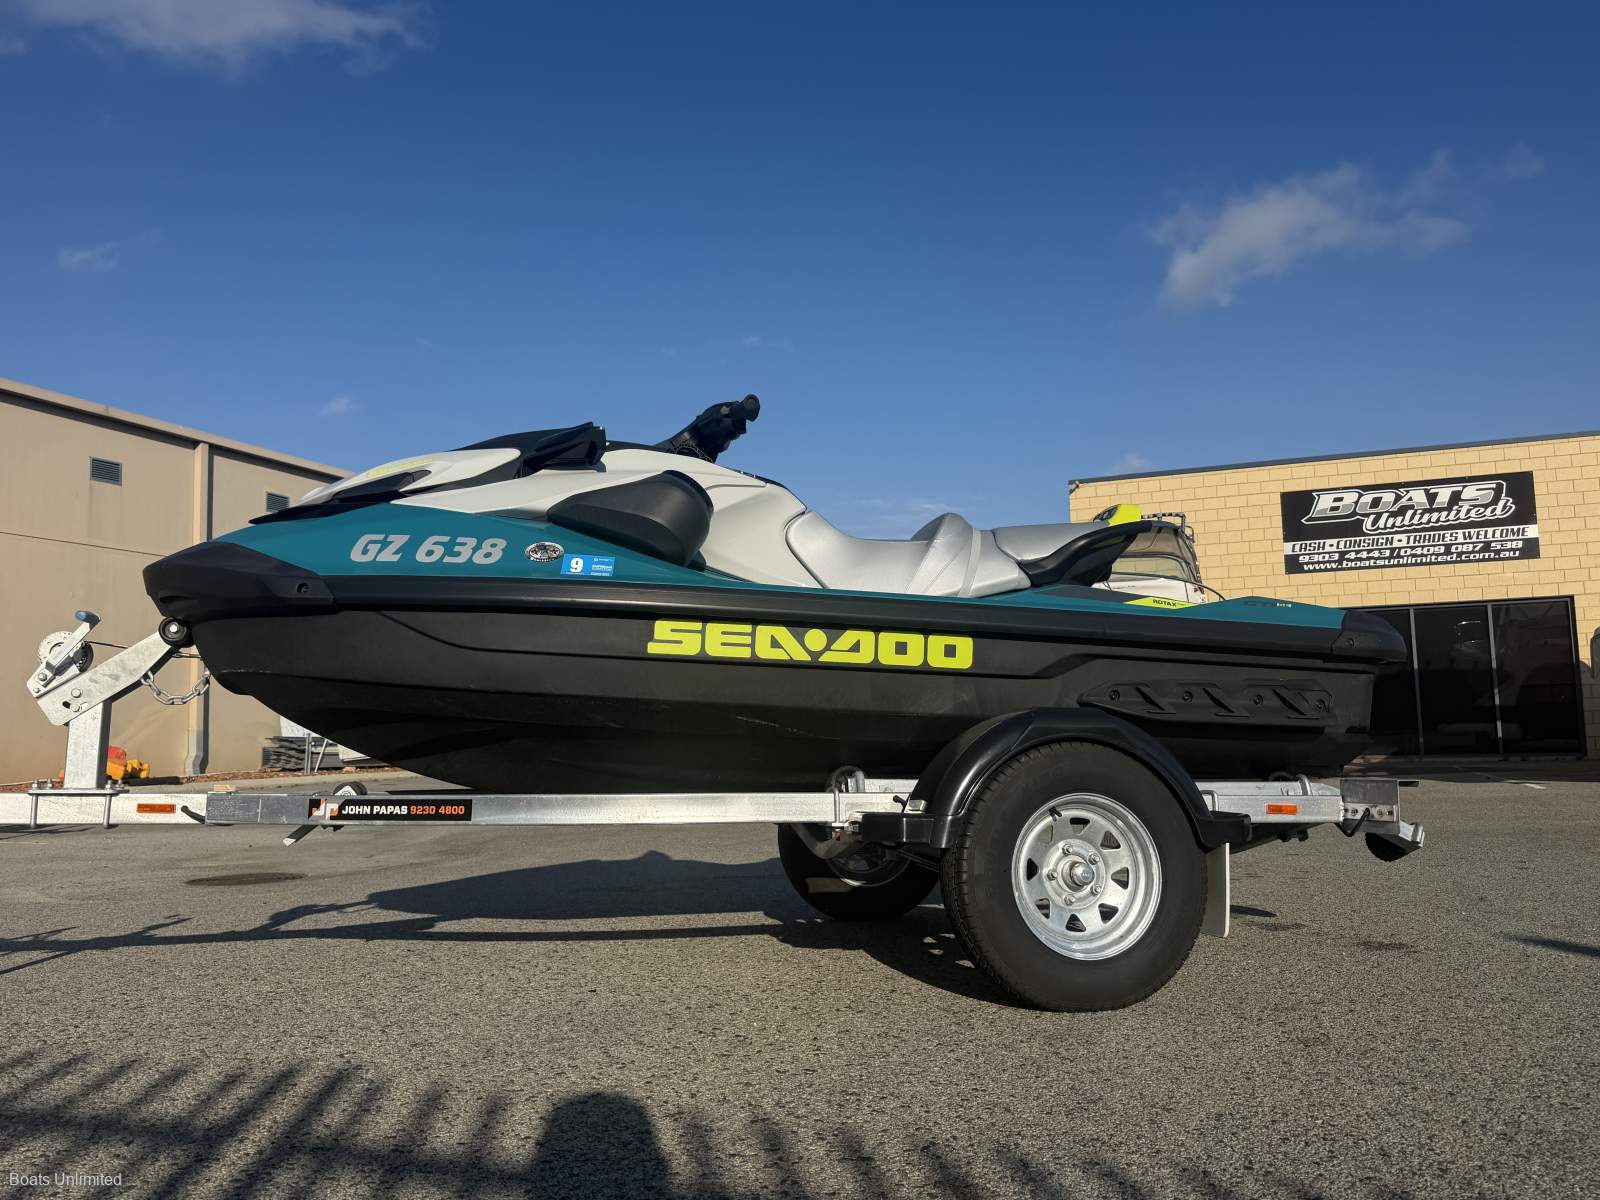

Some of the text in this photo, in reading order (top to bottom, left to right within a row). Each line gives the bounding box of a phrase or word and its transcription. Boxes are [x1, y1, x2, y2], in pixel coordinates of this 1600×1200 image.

[1310, 482, 1497, 518] BOATS
[1366, 500, 1512, 530] Unlimited
[350, 534, 507, 565] GZ 638
[1292, 526, 1530, 553] CASH CONSIGN TRADES WELCOME
[1299, 553, 1339, 563] 9303
[1344, 549, 1390, 560] 4443
[1400, 545, 1445, 556] 0409
[1451, 543, 1484, 553] 087
[1490, 540, 1523, 550] 538
[1303, 550, 1520, 571] www.boatsunlimited.com.au
[570, 557, 584, 573] 9
[1152, 599, 1177, 607] ROTAX
[342, 805, 465, 815] JOHN PAPAS 9230 4800
